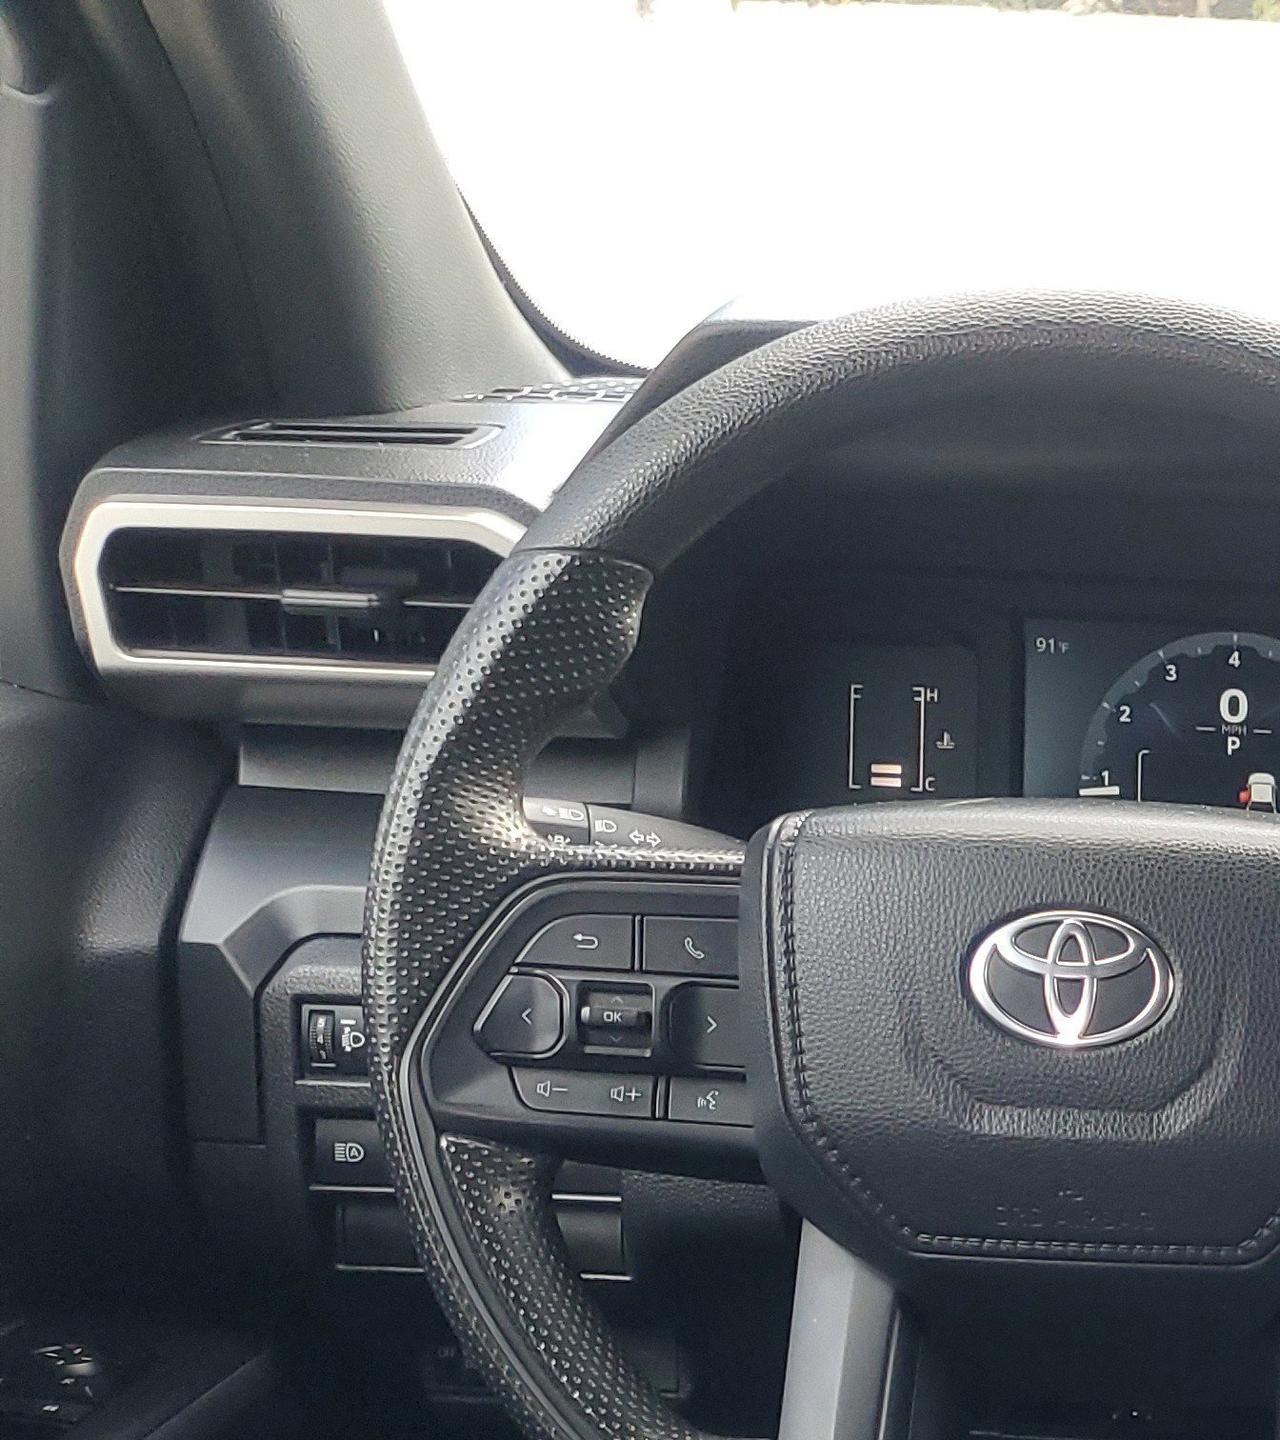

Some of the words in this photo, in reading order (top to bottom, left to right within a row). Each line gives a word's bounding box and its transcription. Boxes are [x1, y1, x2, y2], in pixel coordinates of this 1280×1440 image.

[1228, 651, 1241, 668] 4
[1164, 664, 1178, 682] 3
[926, 687, 938, 703] H
[1118, 705, 1131, 723] 2
[1219, 688, 1249, 724] 0
[1221, 724, 1247, 736] MPH
[1227, 737, 1240, 755] P
[925, 776, 936, 792] C
[1100, 770, 1111, 786] 1
[602, 1010, 623, 1024] OK
